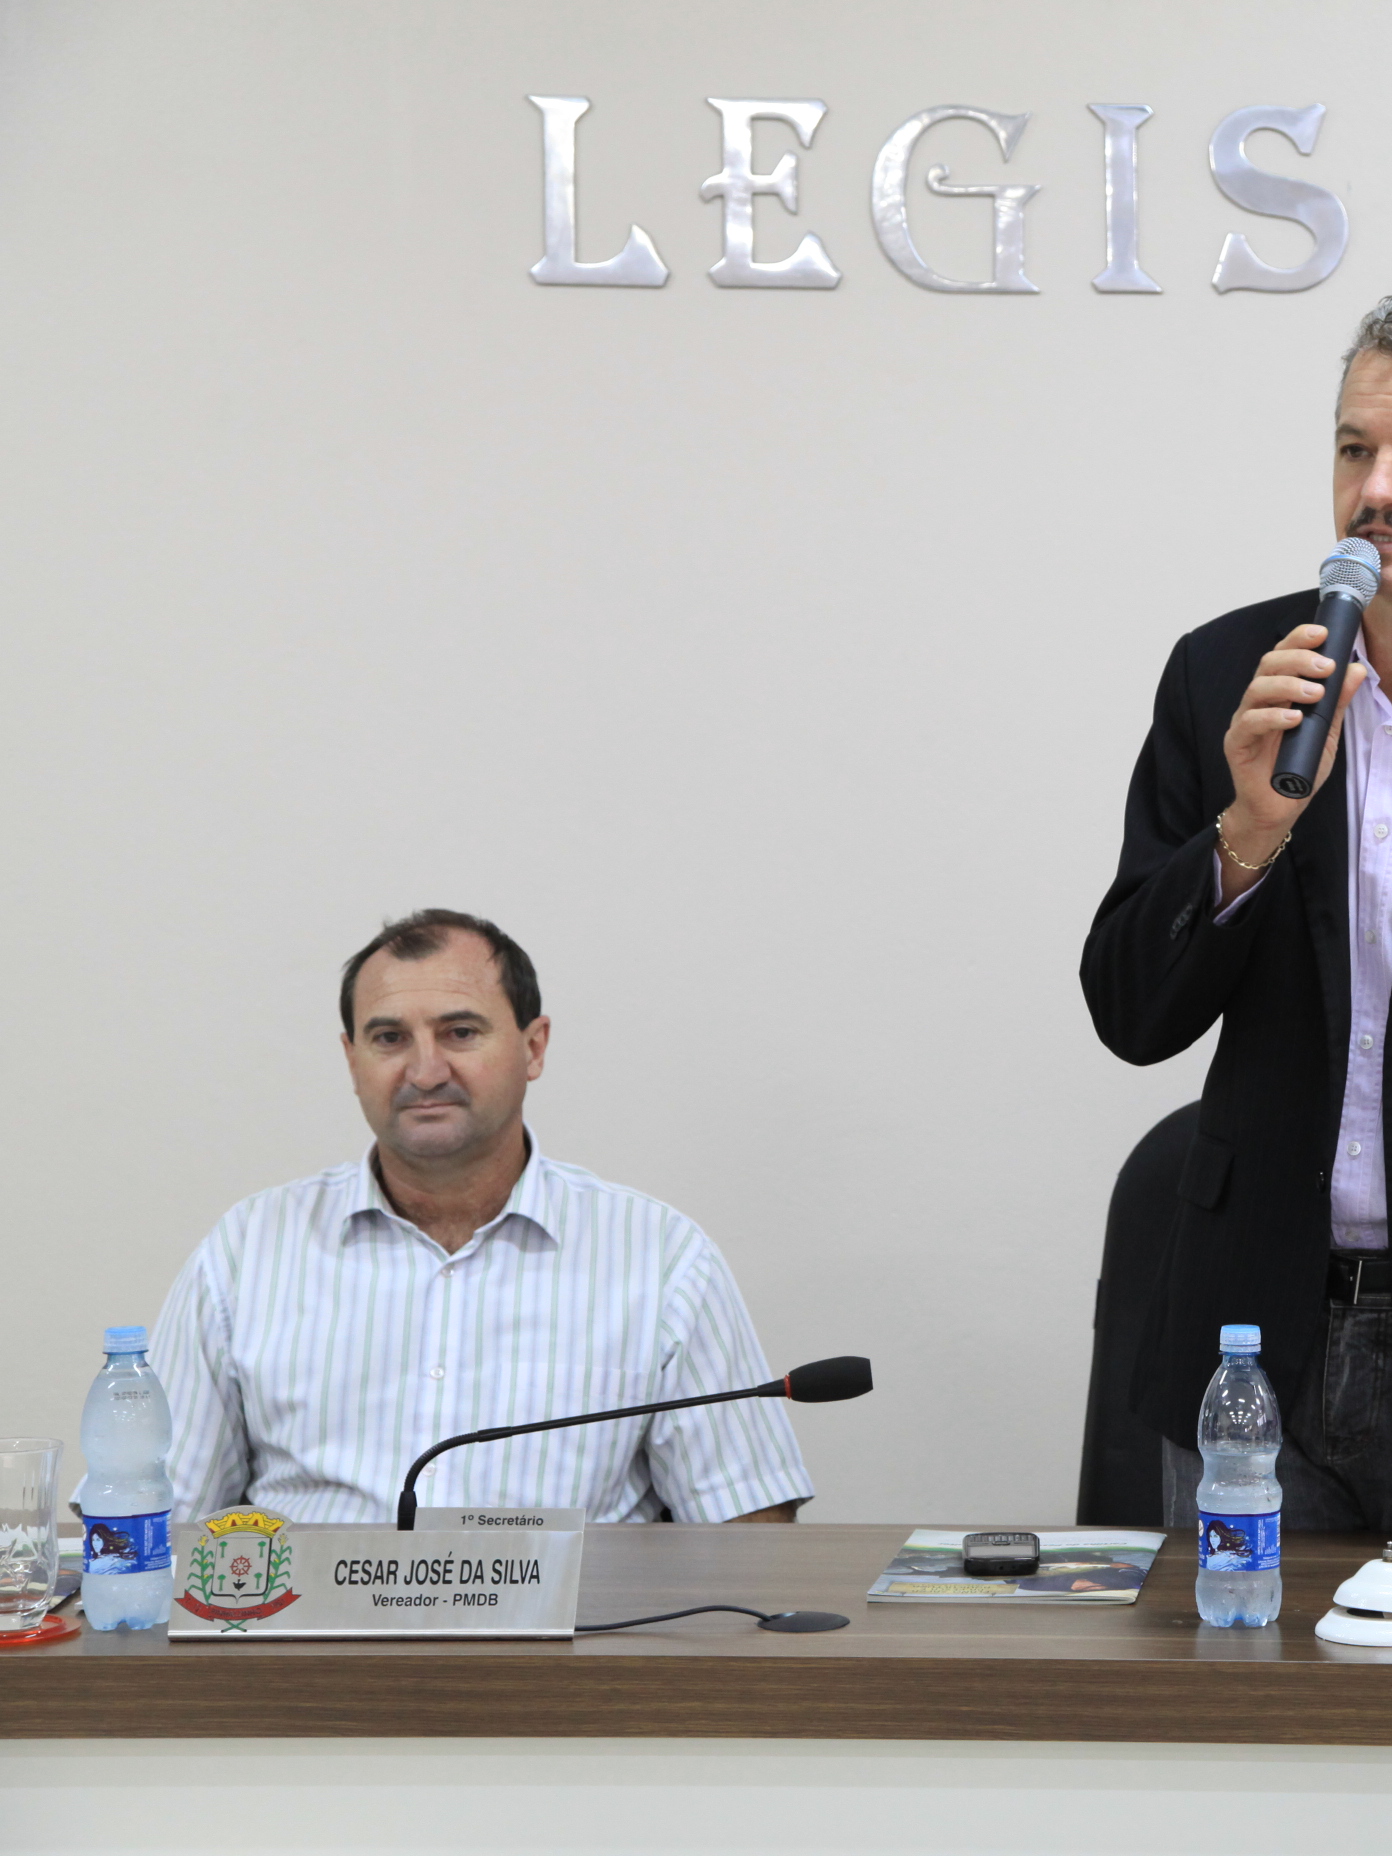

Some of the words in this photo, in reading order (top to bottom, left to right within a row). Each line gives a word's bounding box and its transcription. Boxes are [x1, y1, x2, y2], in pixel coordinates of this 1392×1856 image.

[460, 1514, 474, 1526] 1º
[477, 1514, 544, 1526] Secretário
[334, 1559, 399, 1586] CESAR
[404, 1551, 454, 1586] JOSÉ
[459, 1559, 485, 1585] DA
[491, 1559, 541, 1585] SILVA
[372, 1593, 439, 1607] Vereador
[452, 1593, 499, 1606] PMDB
